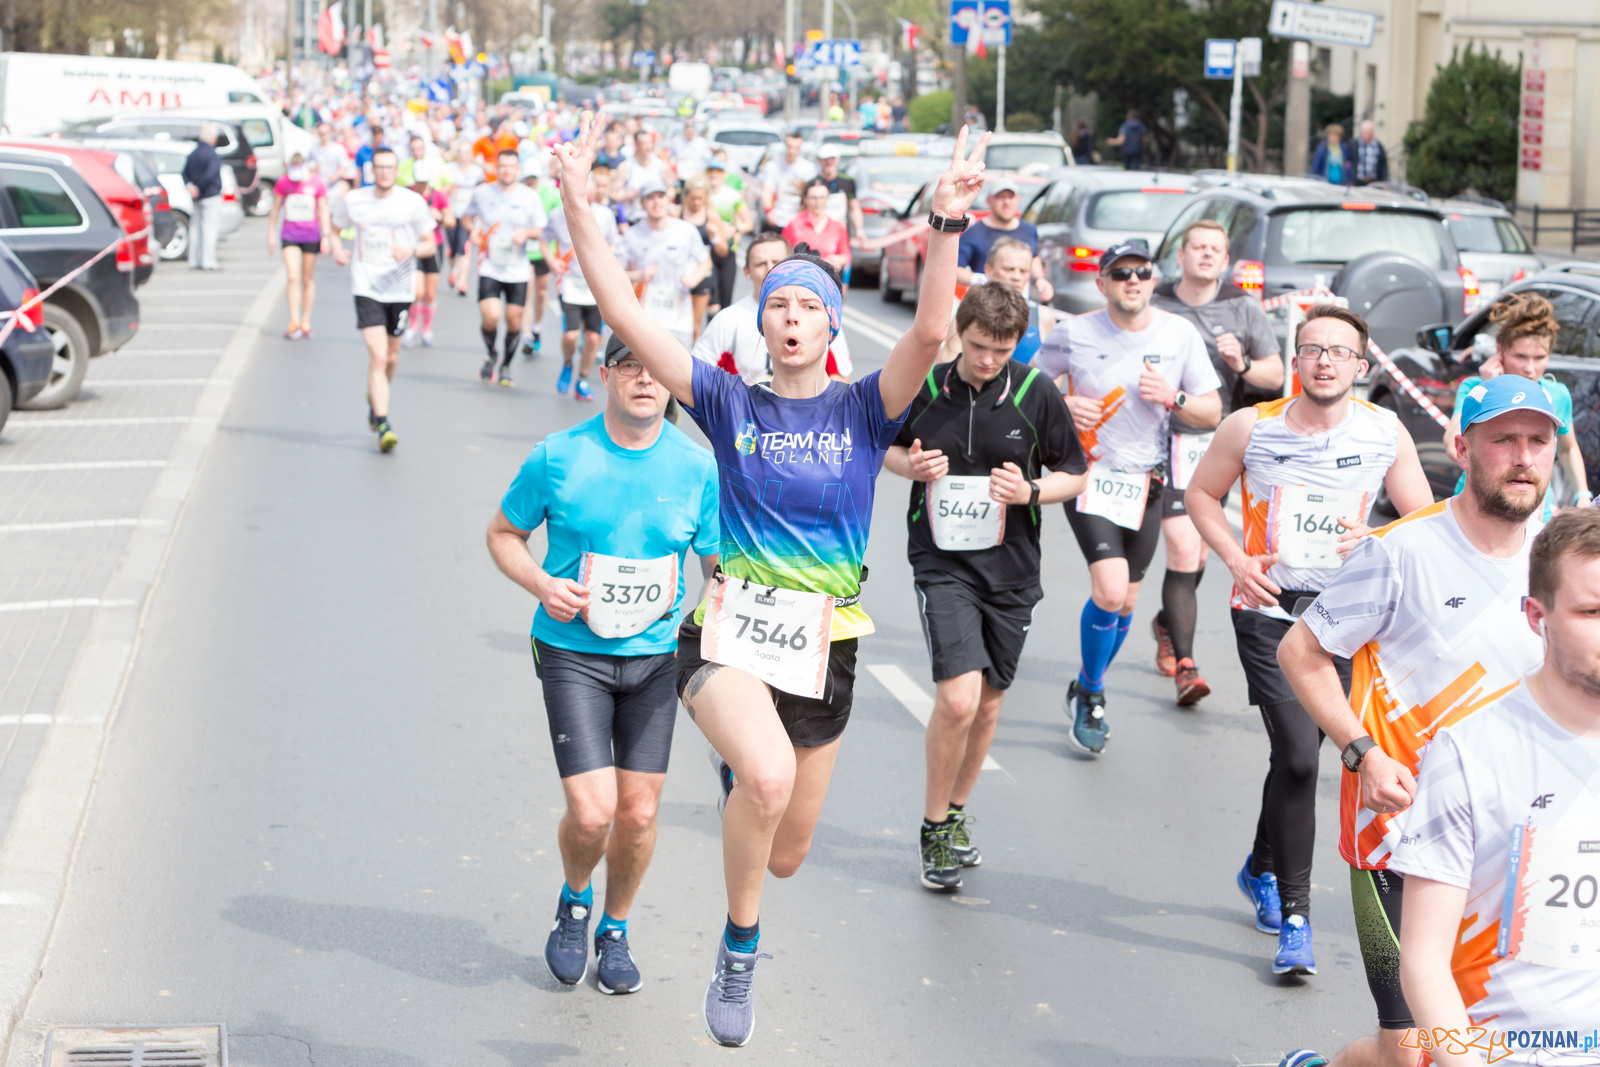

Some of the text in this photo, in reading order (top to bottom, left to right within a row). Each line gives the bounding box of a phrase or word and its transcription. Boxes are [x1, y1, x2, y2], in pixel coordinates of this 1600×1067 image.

[89, 88, 182, 110] AMB
[761, 431, 814, 451] TEAM
[817, 427, 852, 451] RUN
[1339, 457, 1361, 467] 11.PKO
[1094, 478, 1143, 501] 10737
[938, 499, 991, 520] 5447
[1306, 538, 1332, 546] Tomasz
[600, 582, 662, 605] 3370
[614, 608, 646, 617] Krzysztof
[735, 613, 808, 651] 7546
[753, 649, 781, 663] Agata
[1531, 793, 1555, 809] 4F
